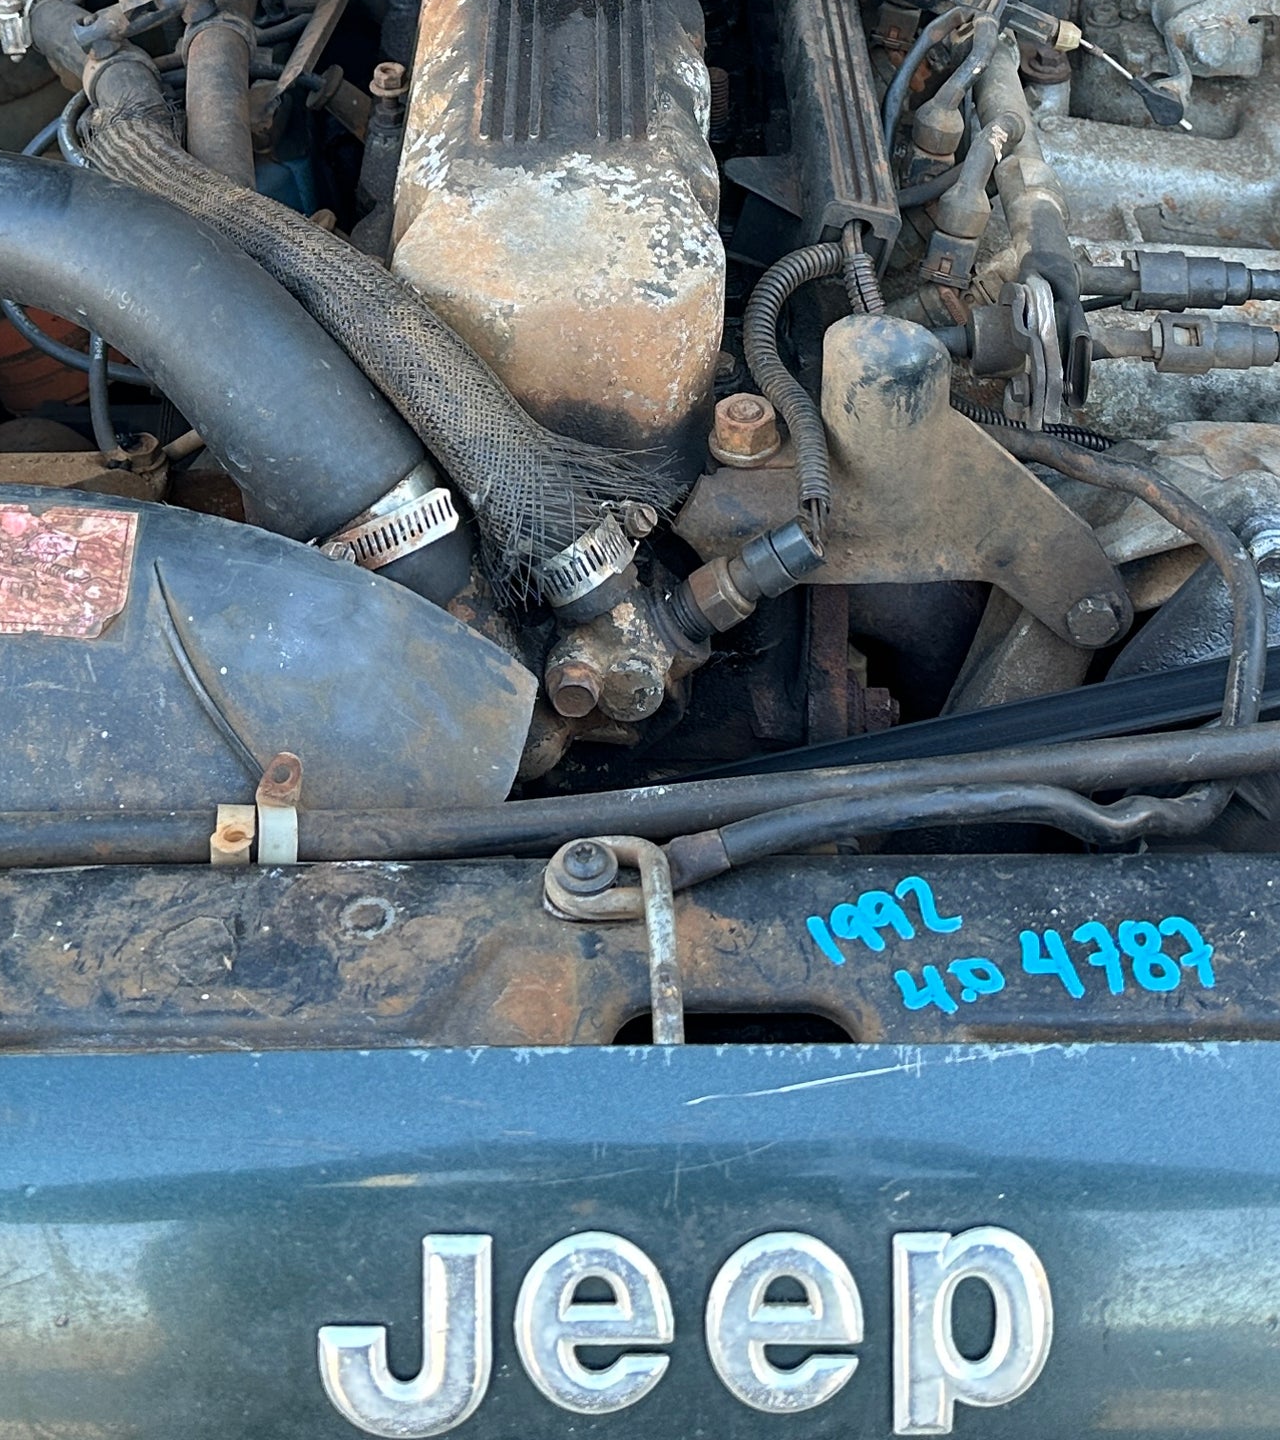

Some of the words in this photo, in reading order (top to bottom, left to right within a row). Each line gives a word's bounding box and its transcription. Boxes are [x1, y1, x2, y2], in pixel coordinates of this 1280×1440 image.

[806, 875, 963, 966] 1992
[1020, 916, 1216, 999] 4787
[318, 1226, 1055, 1440] Jeep
